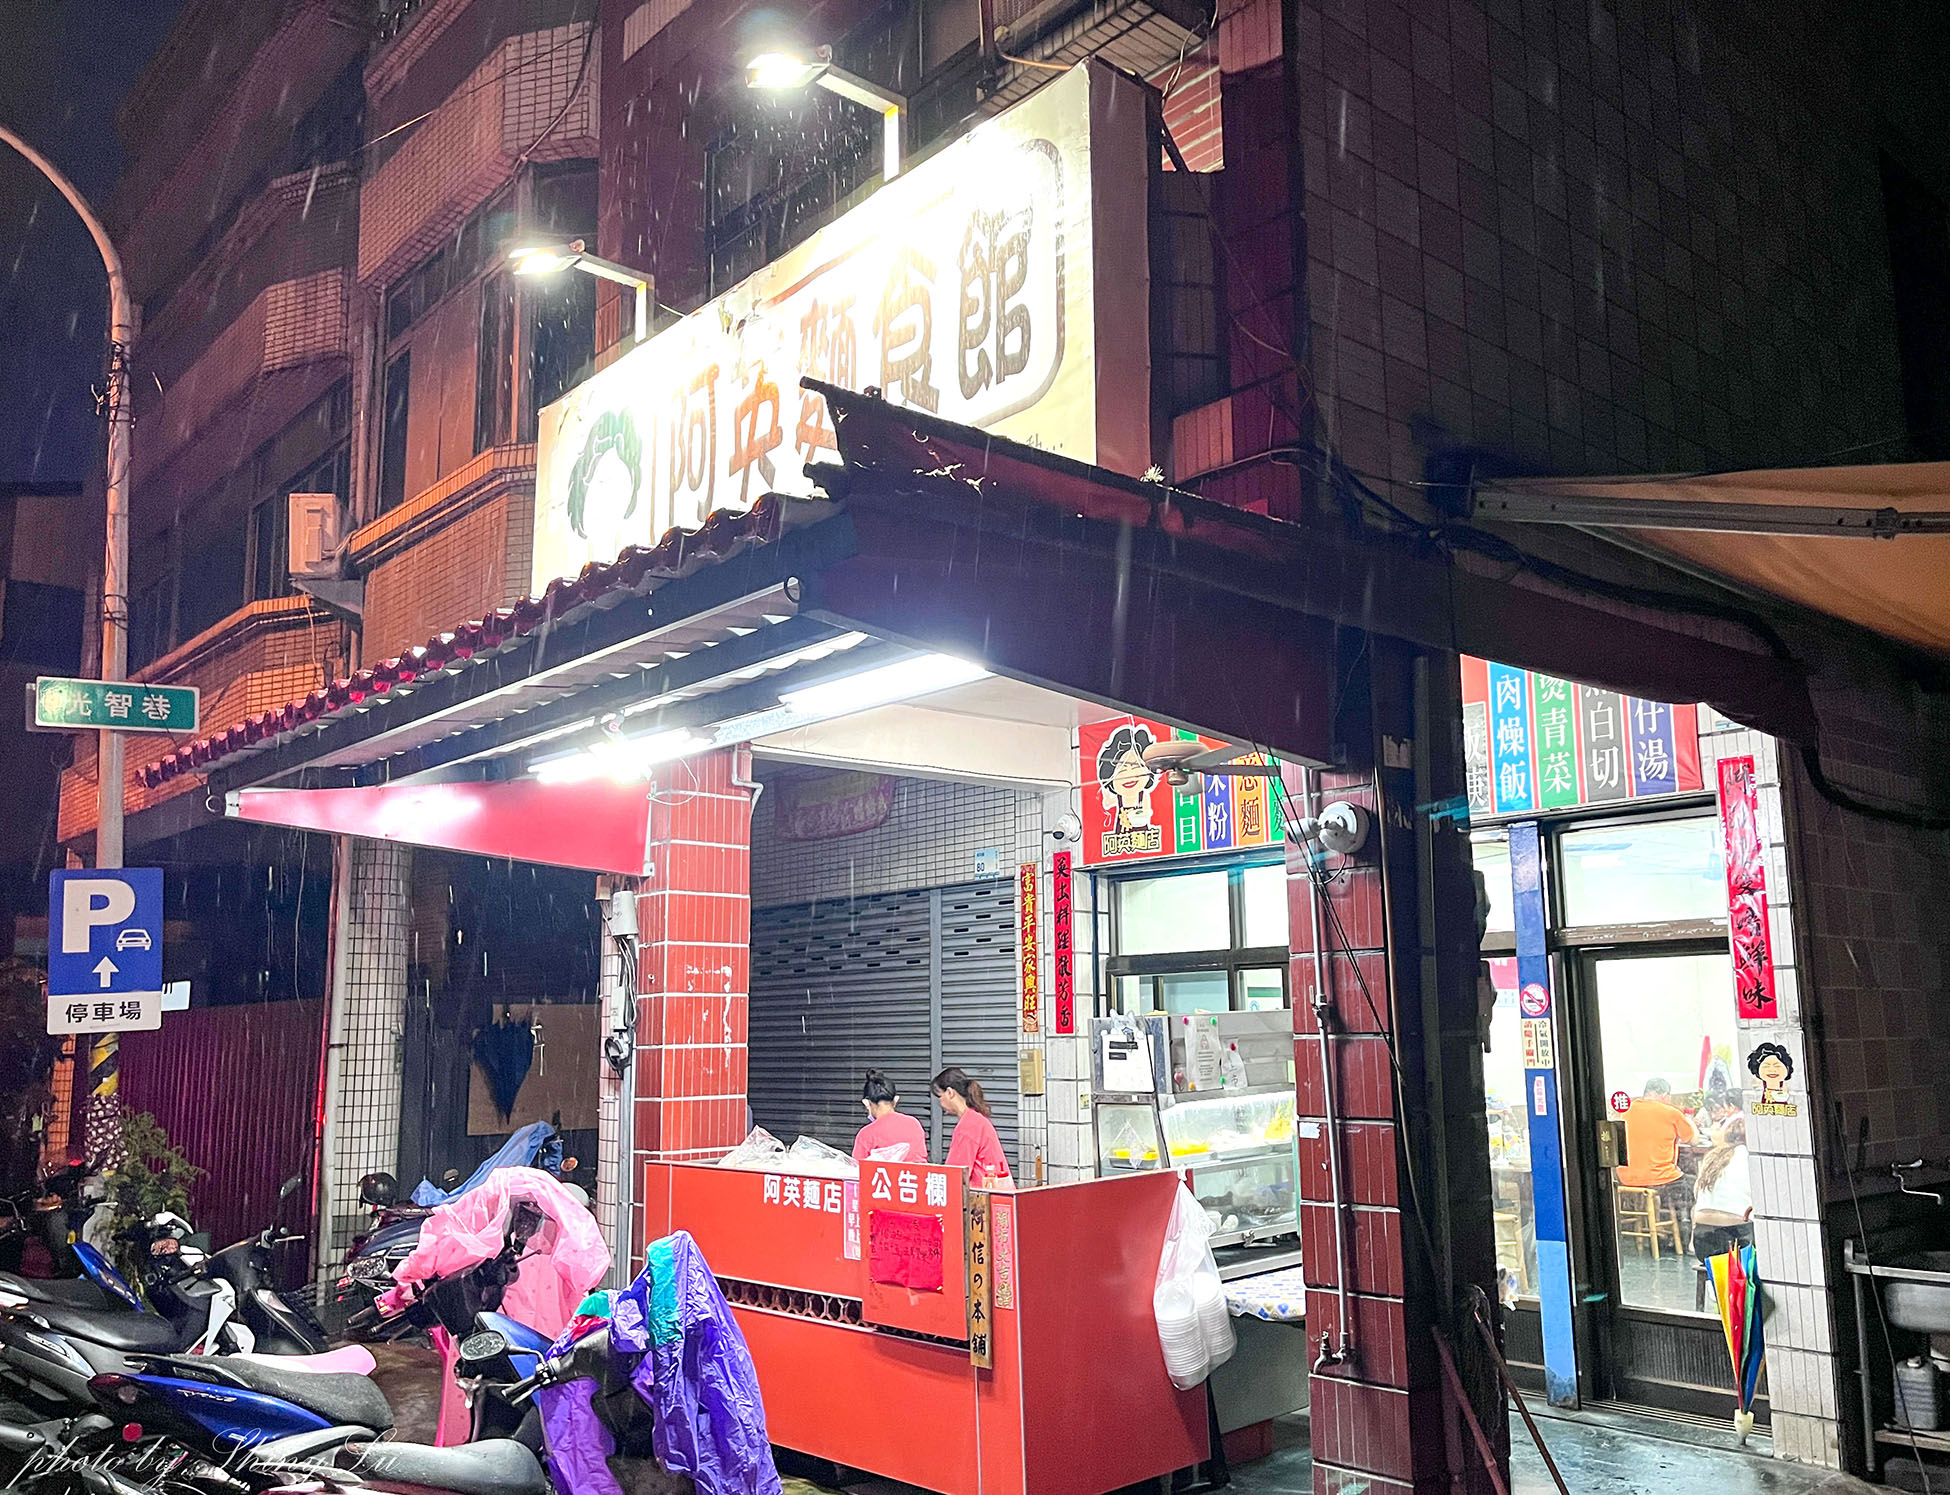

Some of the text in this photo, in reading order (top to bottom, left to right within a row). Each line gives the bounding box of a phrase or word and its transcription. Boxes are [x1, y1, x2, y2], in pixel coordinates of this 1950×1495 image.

[1495, 674, 1528, 804] 肉燥飯
[1539, 673, 1572, 793] 燙青菜
[1585, 686, 1620, 789] 白切
[1103, 830, 1161, 856] 阿英麵店
[62, 879, 136, 953] P
[1022, 872, 1037, 1011] 富貴平安家興旺
[65, 1000, 142, 1023] 停車場
[1614, 1094, 1629, 1110] 推
[763, 1175, 842, 1214] 阿英麵店
[871, 1167, 948, 1207] 公告欄
